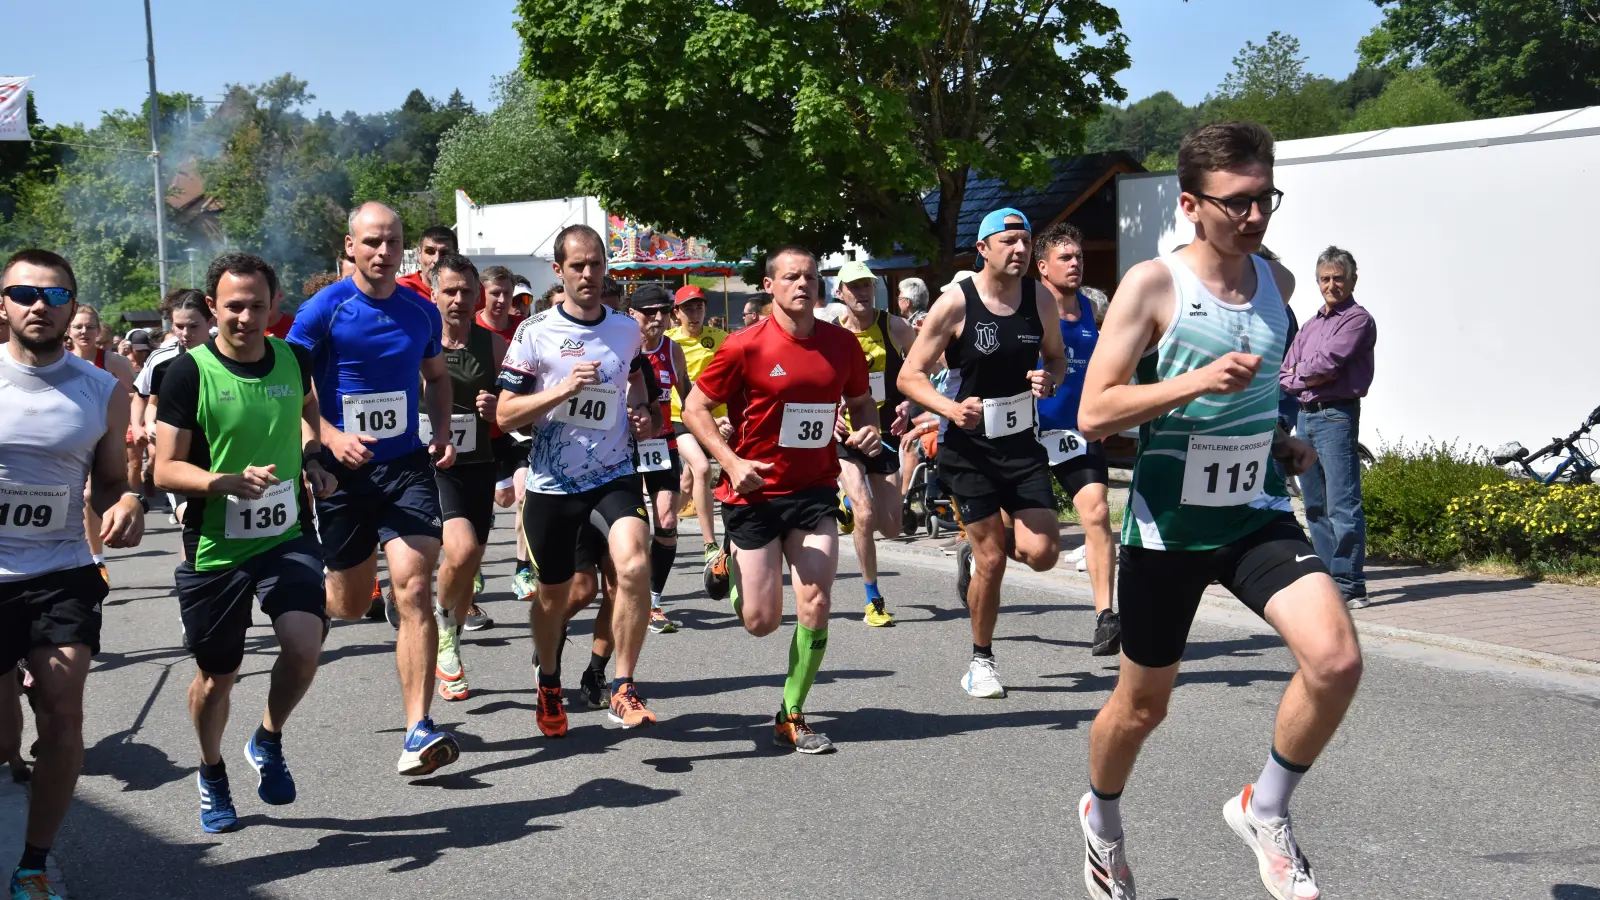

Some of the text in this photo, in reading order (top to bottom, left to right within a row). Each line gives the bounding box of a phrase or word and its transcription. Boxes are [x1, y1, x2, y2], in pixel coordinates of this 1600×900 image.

[978, 326, 995, 349] TSG
[355, 409, 397, 432] 103
[568, 397, 606, 421] 140
[1006, 410, 1018, 429] 5
[797, 420, 824, 441] 38
[1058, 434, 1080, 454] 46
[1191, 438, 1272, 452] DENTLEINER CROSSLAUF
[1203, 460, 1259, 494] 113
[264, 484, 293, 499] CROSSLAUF
[0, 502, 53, 528] 109
[239, 502, 287, 531] 136
